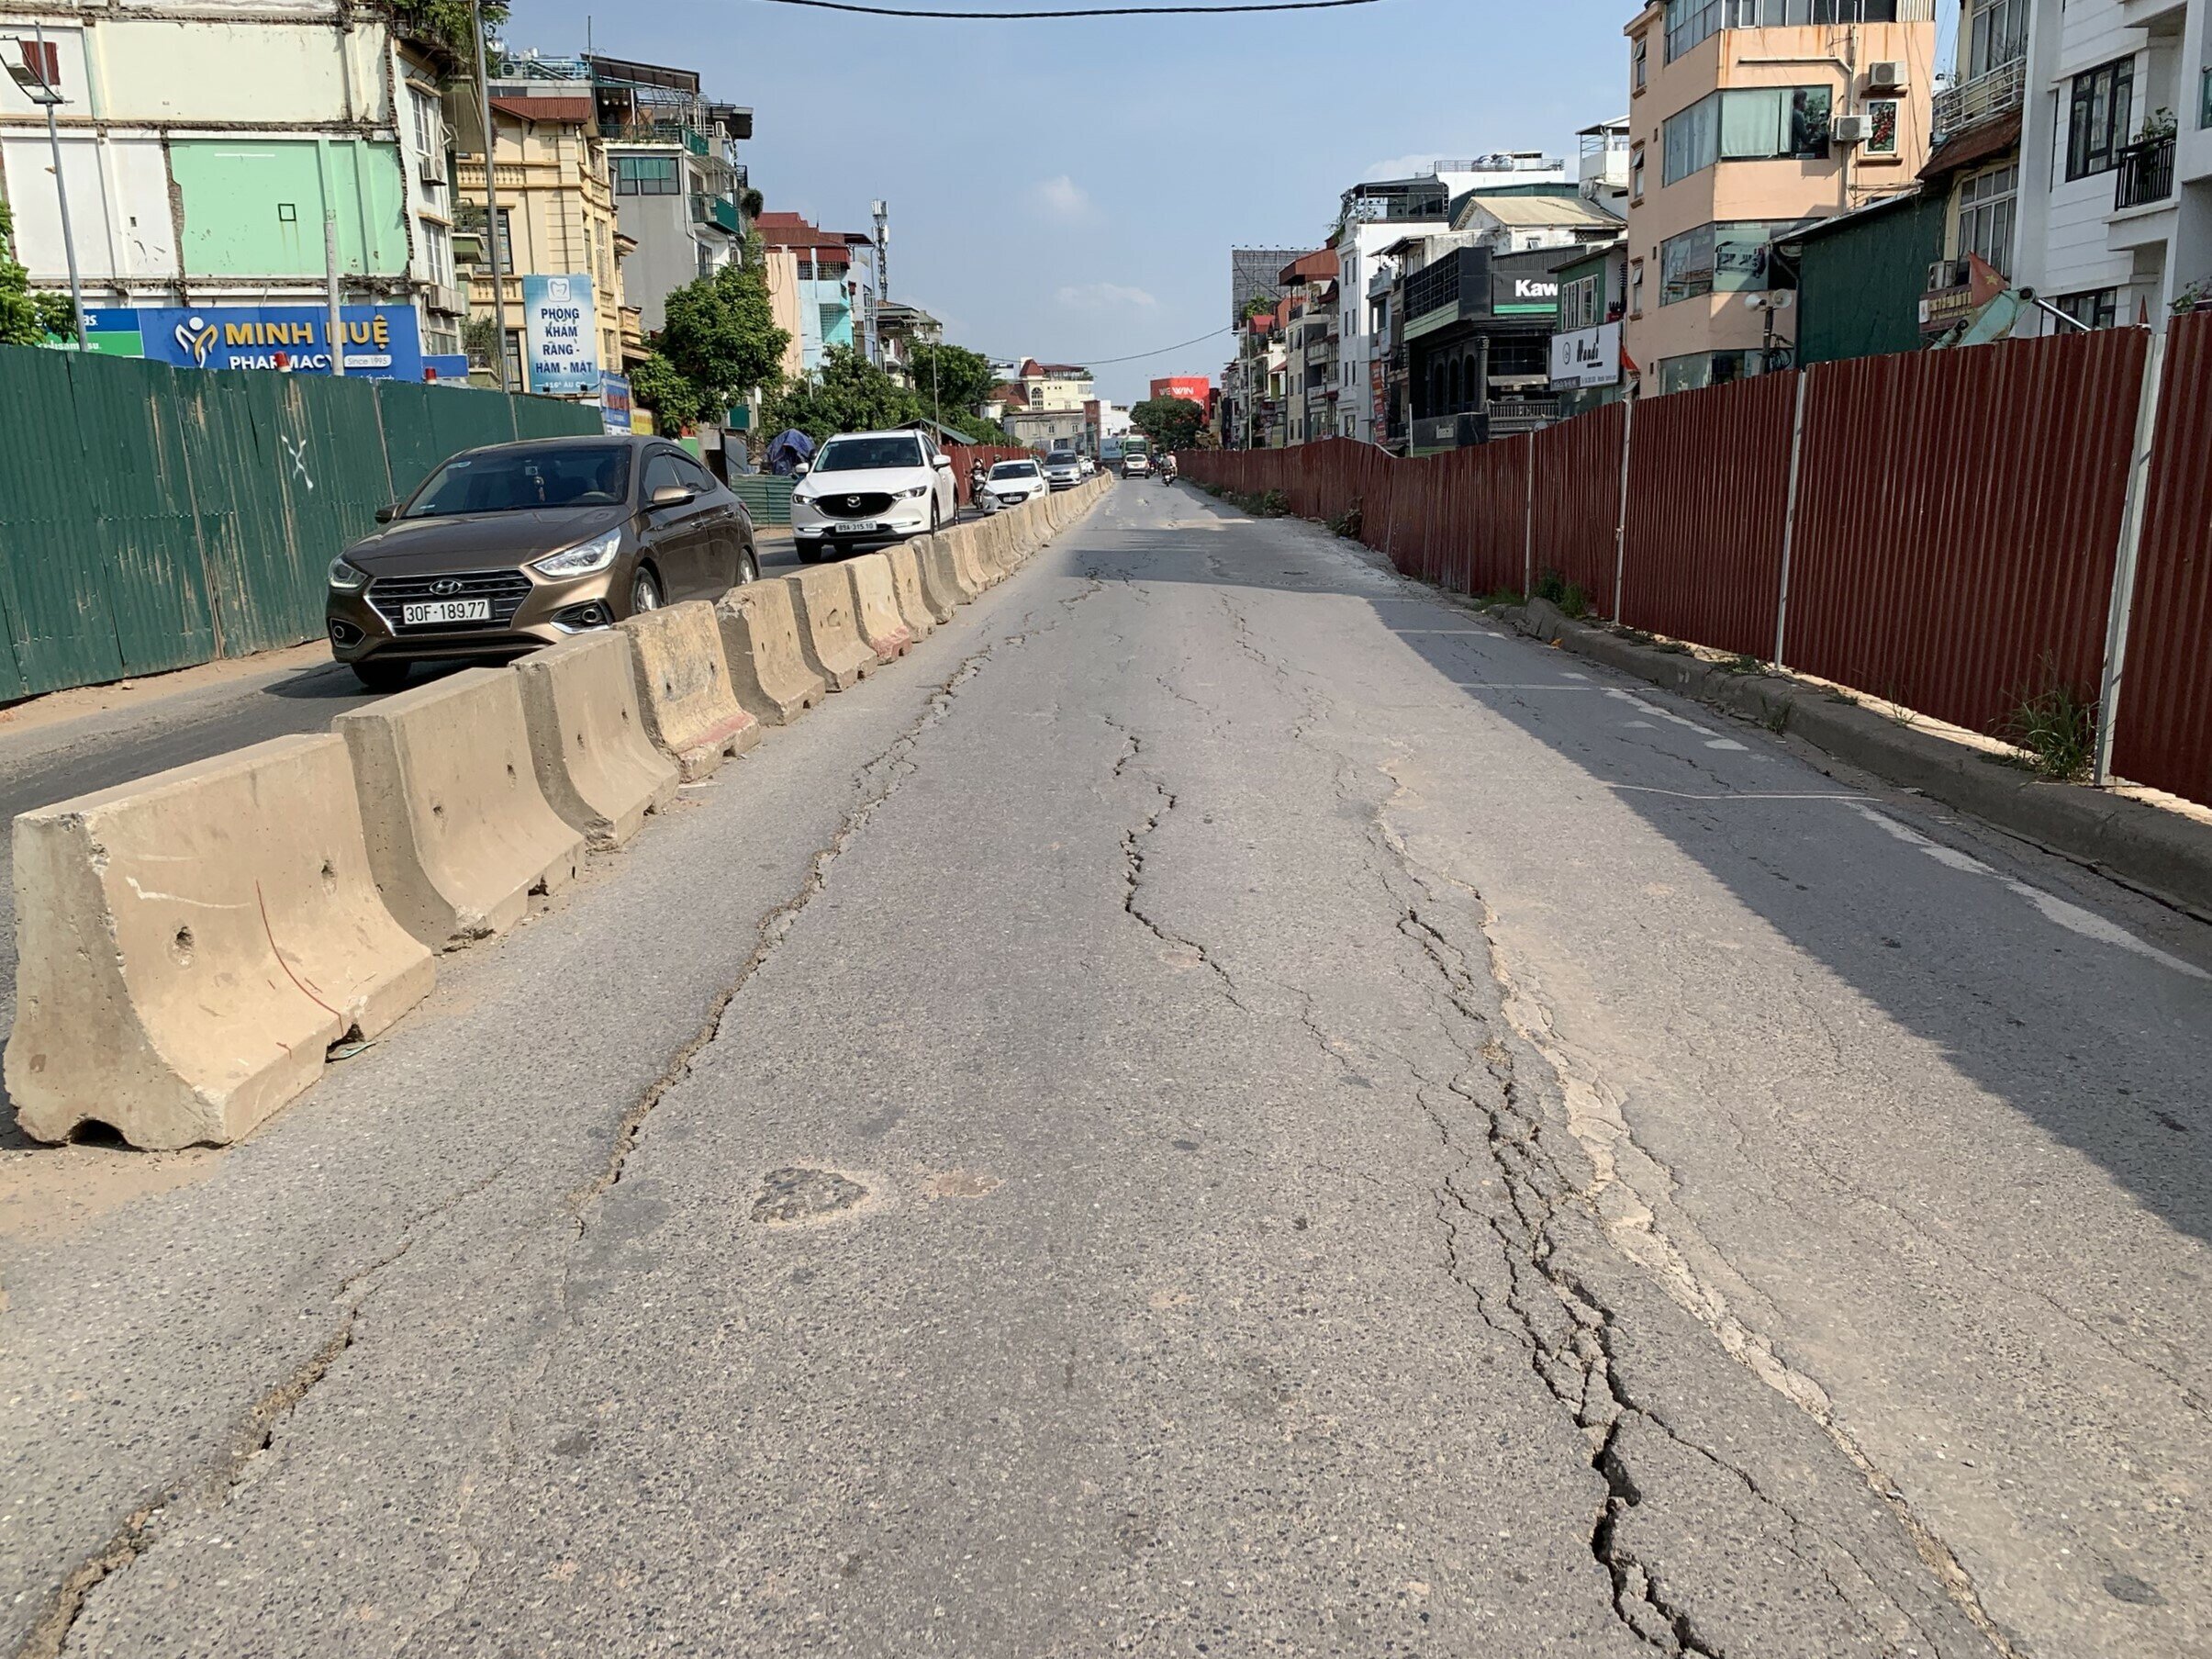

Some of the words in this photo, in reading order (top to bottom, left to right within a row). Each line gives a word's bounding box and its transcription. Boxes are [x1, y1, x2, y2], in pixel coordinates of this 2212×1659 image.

[1515, 279, 1558, 297] Kaw
[541, 305, 579, 319] PHÒNG
[225, 322, 314, 345] MINH
[545, 323, 577, 337] KHÁM
[348, 357, 368, 365] Since
[371, 357, 387, 365] 1995
[535, 360, 560, 373] HÀM
[1158, 387, 1171, 396] WE
[1172, 387, 1194, 396] WIN
[406, 601, 486, 622] 30F-189.77
